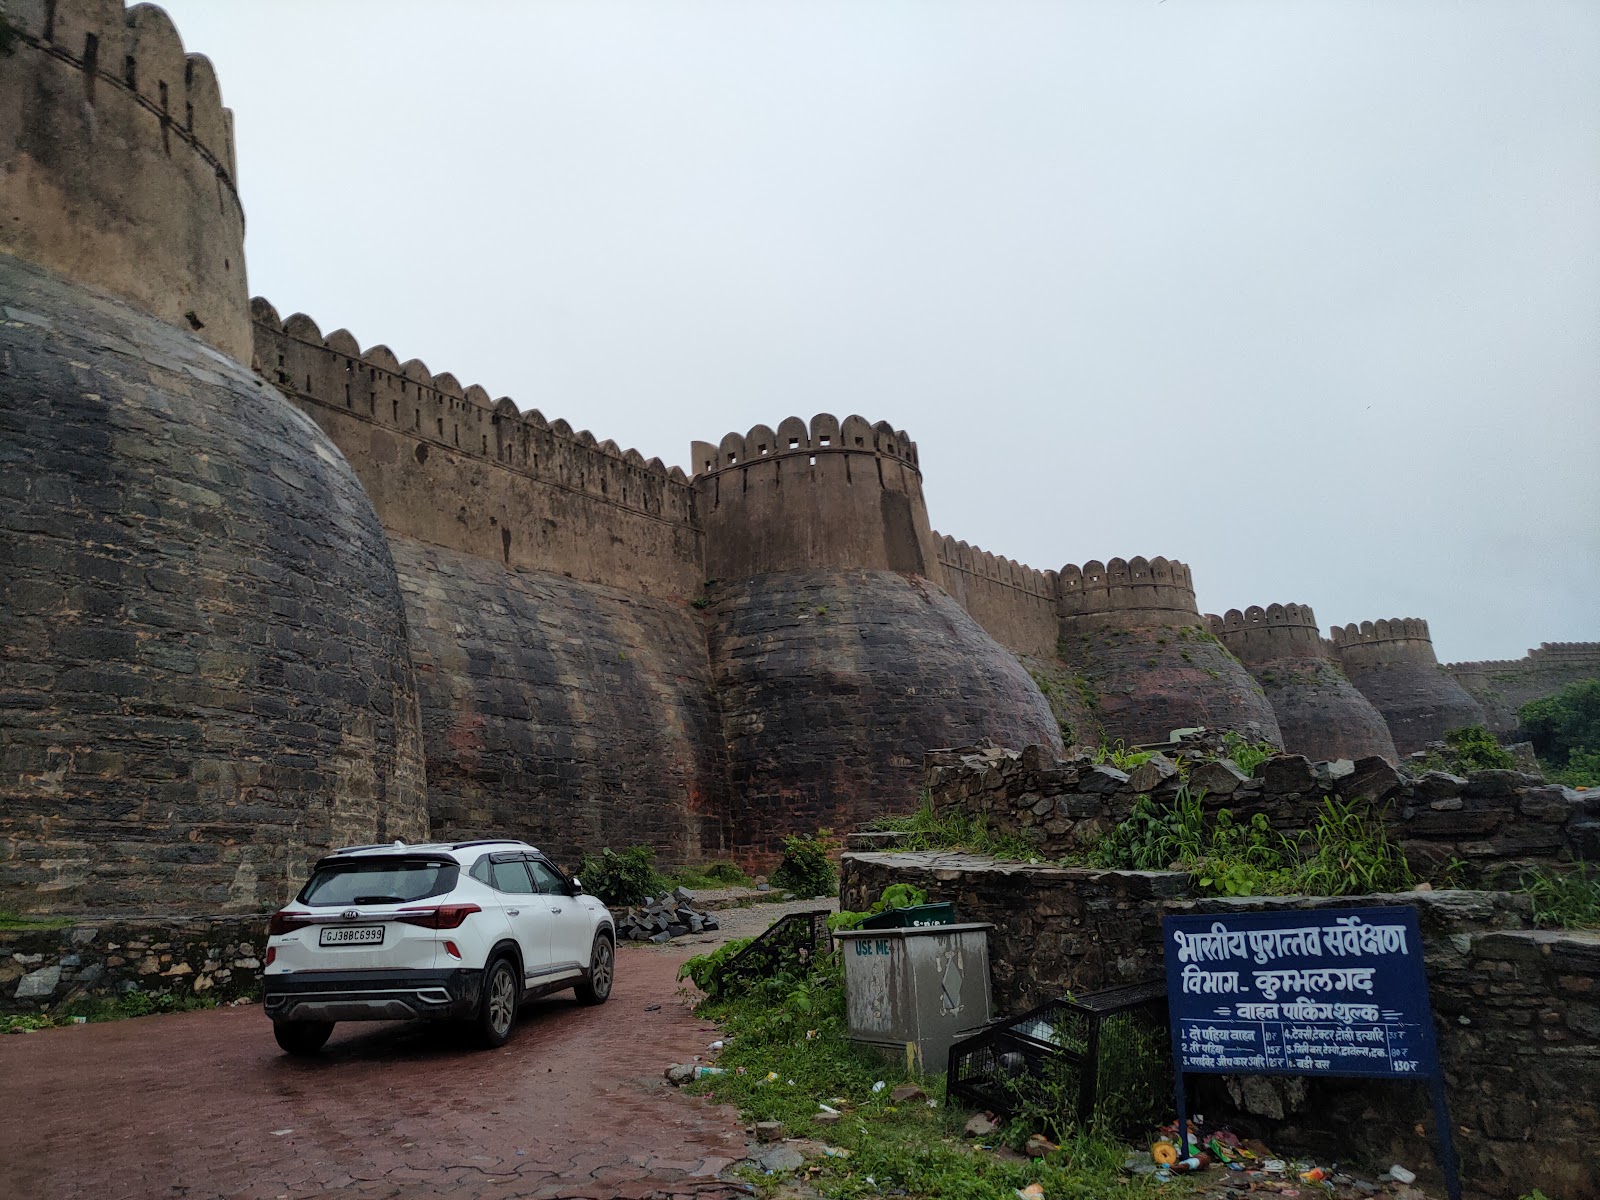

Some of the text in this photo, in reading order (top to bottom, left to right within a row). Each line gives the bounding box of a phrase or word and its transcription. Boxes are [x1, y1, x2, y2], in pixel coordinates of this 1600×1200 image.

[343, 910, 358, 919] KIA
[326, 930, 382, 942] GJ38BC6999
[1174, 922, 1248, 962] भारतीय
[1322, 916, 1409, 956] सर्वेक्षण
[855, 940, 890, 956] USE ME
[1252, 968, 1376, 1001] कुम्भलगढ़
[1235, 1002, 1280, 1020] वाहन
[1333, 1002, 1380, 1024] शुल्क
